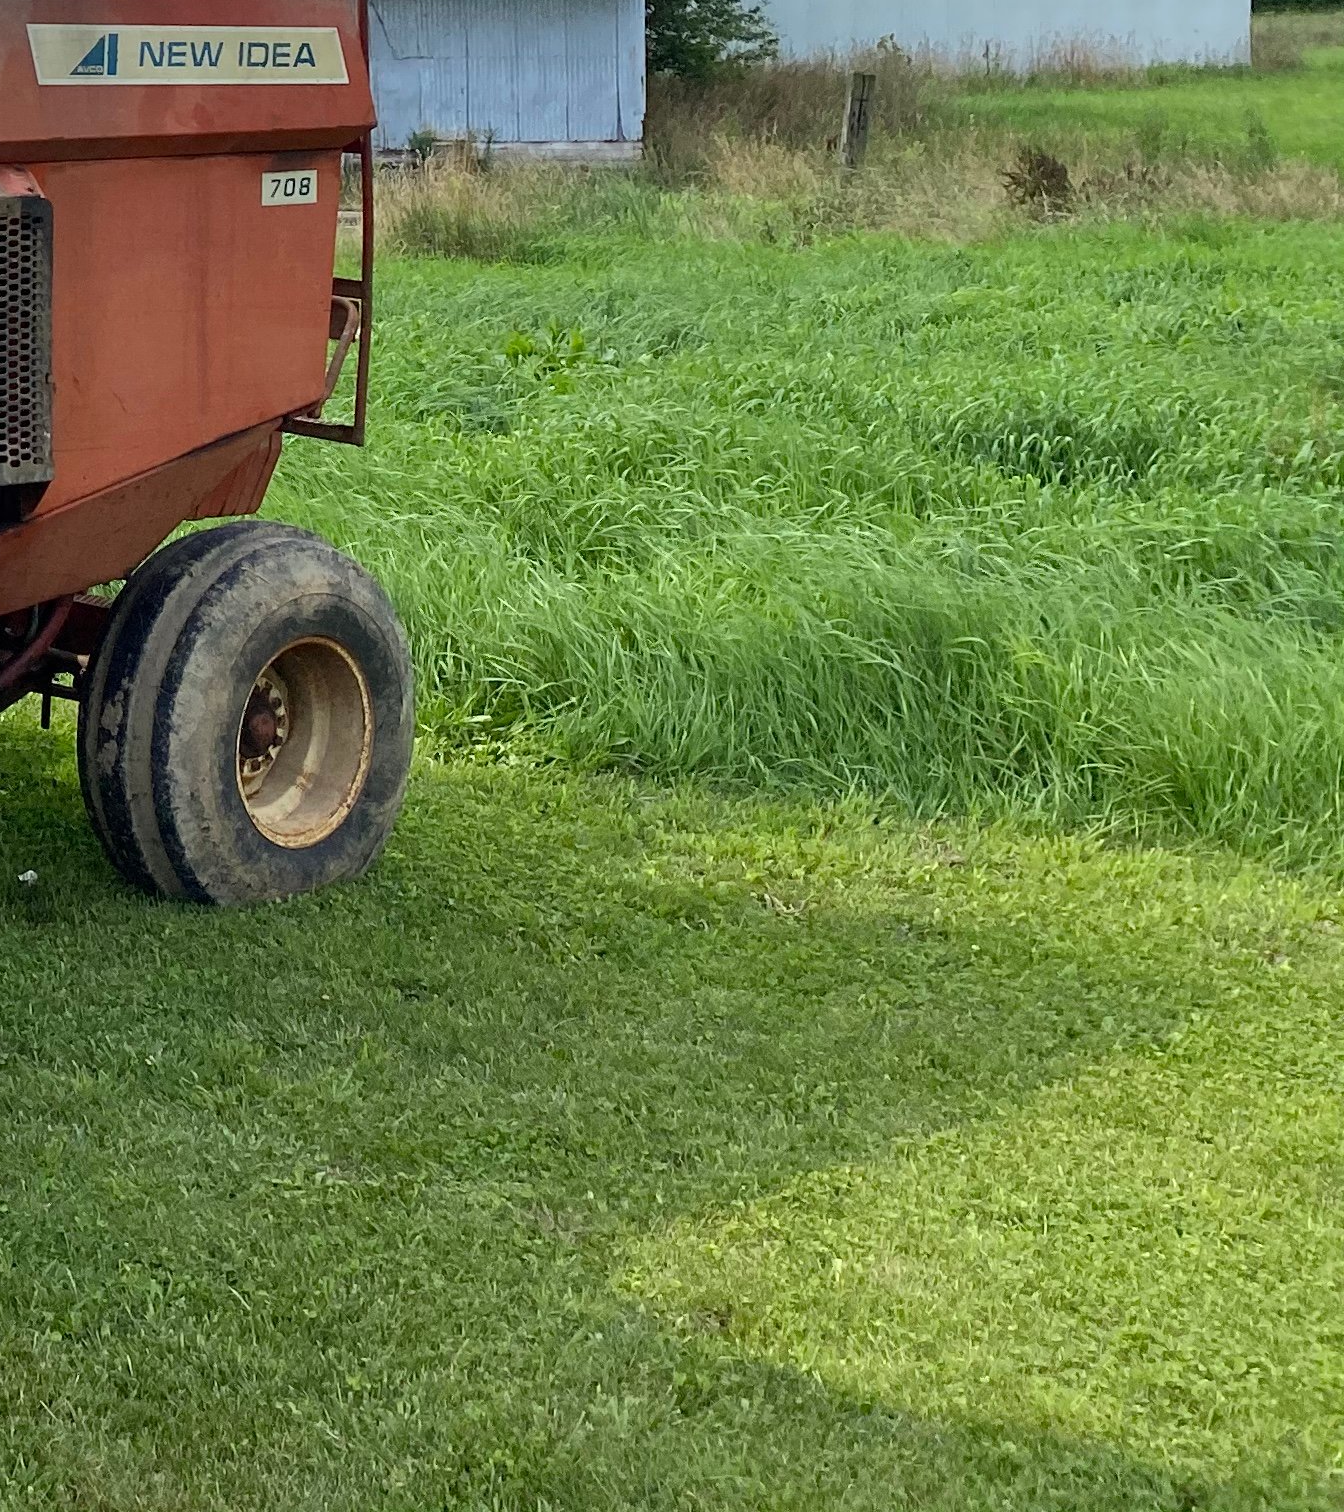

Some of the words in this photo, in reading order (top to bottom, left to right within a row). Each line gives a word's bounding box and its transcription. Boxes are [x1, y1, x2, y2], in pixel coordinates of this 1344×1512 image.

[138, 41, 224, 68] NEW
[238, 42, 316, 68] IDEA
[270, 176, 311, 198] 708
